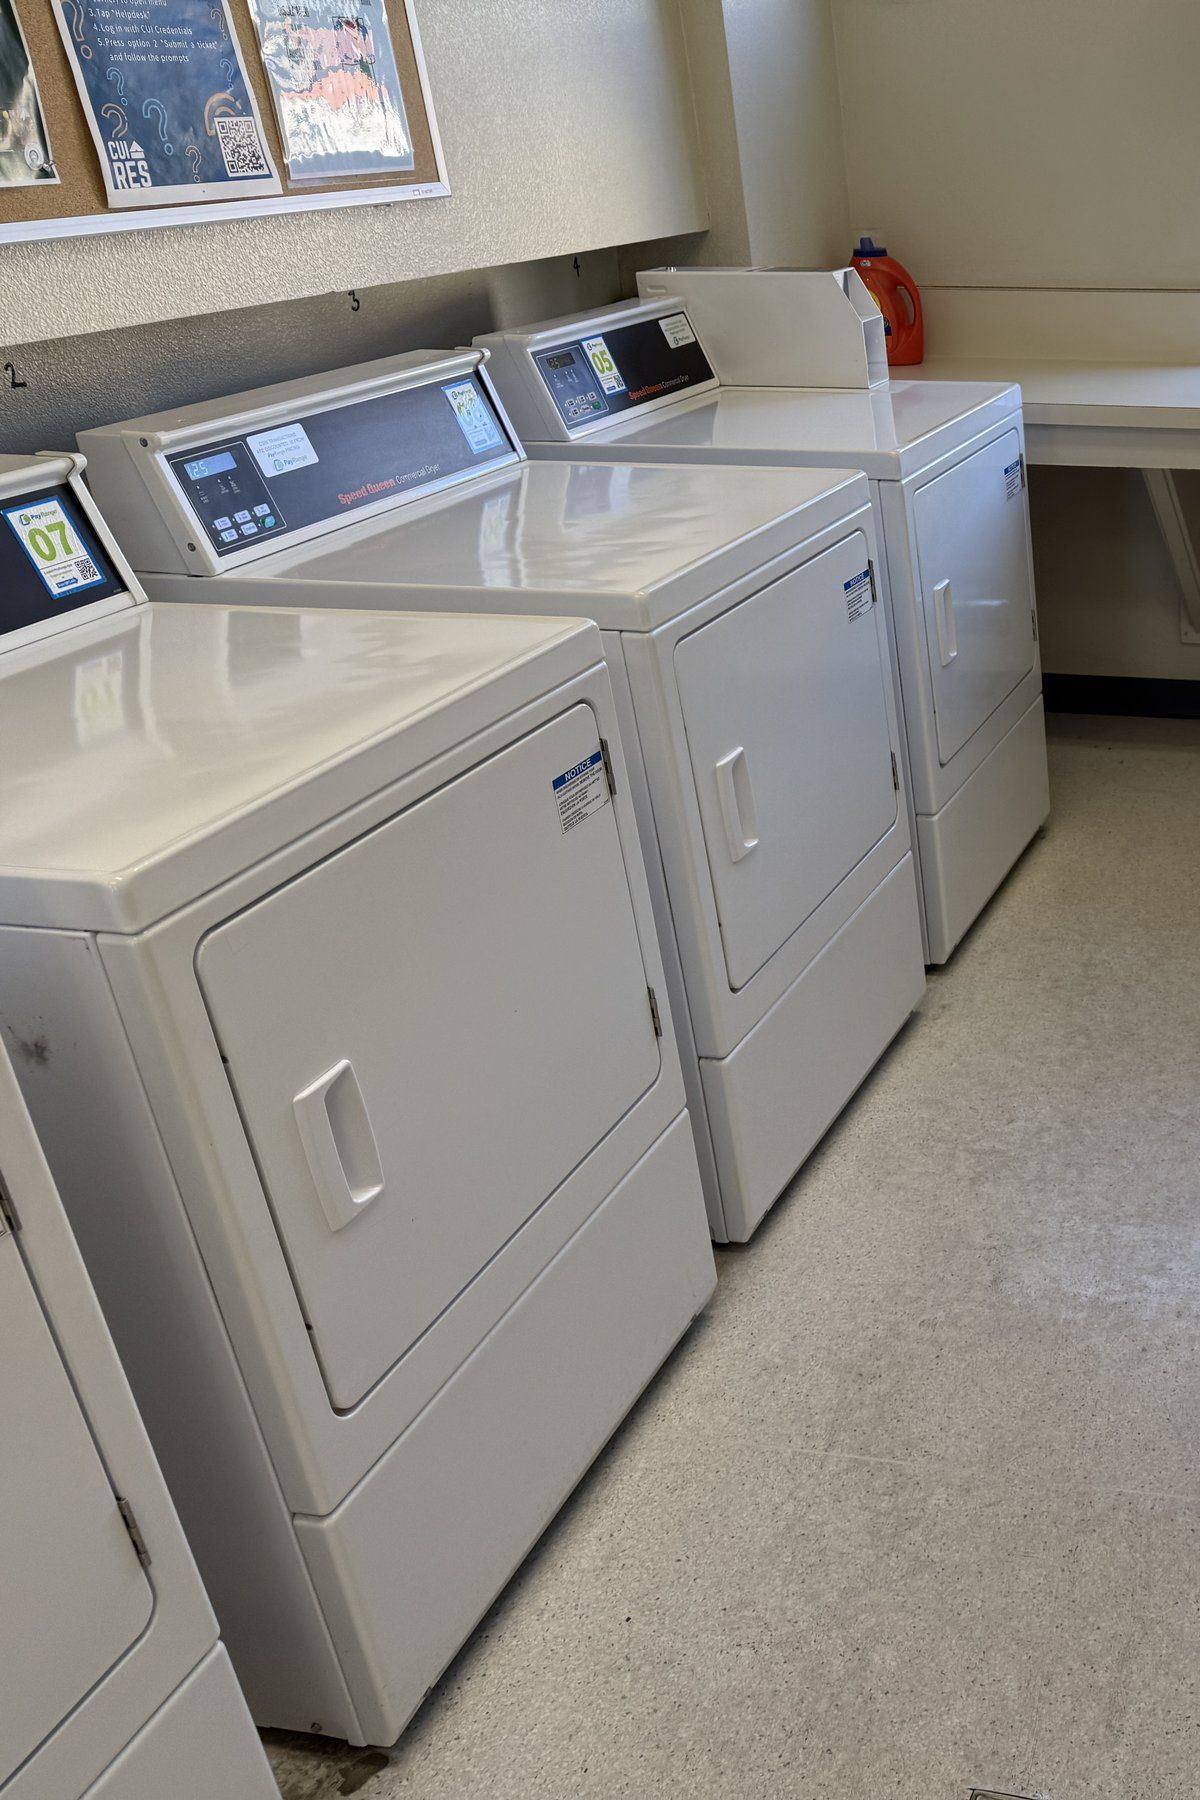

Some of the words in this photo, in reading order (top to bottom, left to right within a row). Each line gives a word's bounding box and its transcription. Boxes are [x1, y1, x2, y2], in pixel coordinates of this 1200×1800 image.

[124, 24, 140, 33] with
[141, 26, 153, 34] CUI
[155, 26, 193, 35] Credentials
[128, 40, 150, 49] option
[153, 40, 158, 48] 2
[110, 52, 122, 61] and
[124, 53, 146, 61] follow
[148, 54, 159, 62] the
[161, 55, 189, 63] prompts
[108, 140, 130, 160] CUI
[113, 161, 152, 189] RES
[573, 256, 581, 278] 4
[348, 290, 360, 312] 3
[592, 350, 614, 374] 05
[4, 361, 28, 389] 2
[629, 387, 647, 400] Speed
[284, 455, 307, 465] PayRange
[338, 487, 368, 505] Speed
[366, 478, 396, 494] Queen
[395, 467, 426, 484] Commercial
[425, 463, 440, 474] Dryer
[30, 510, 58, 520] PayRange
[28, 521, 74, 562] 07
[564, 758, 592, 781] NOTICE
